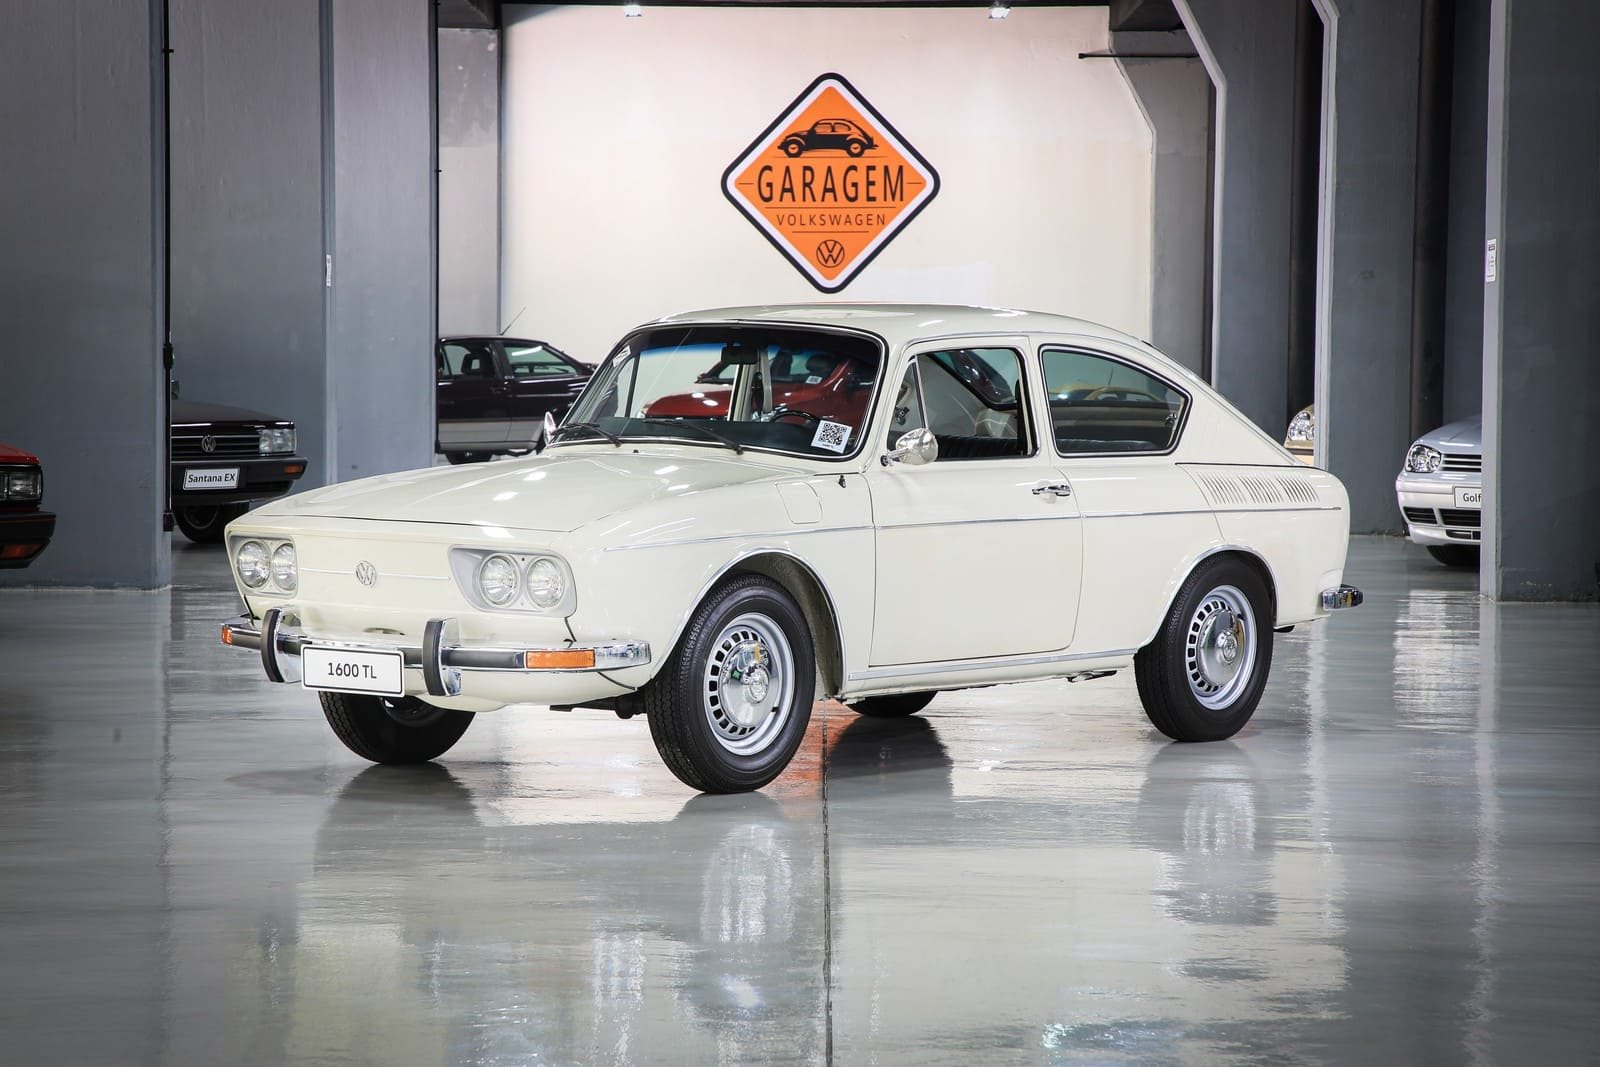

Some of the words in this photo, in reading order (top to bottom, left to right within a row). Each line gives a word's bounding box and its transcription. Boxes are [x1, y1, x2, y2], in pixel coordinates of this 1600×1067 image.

[757, 165, 904, 202] GARAGEM
[776, 213, 886, 226] VOLKSWAGEN
[816, 239, 845, 268] VW
[188, 474, 222, 483] Santana
[224, 473, 236, 482] EX
[1463, 493, 1482, 503] Golf
[355, 560, 377, 588] VW
[328, 662, 359, 678] 1600
[362, 664, 377, 679] TL
